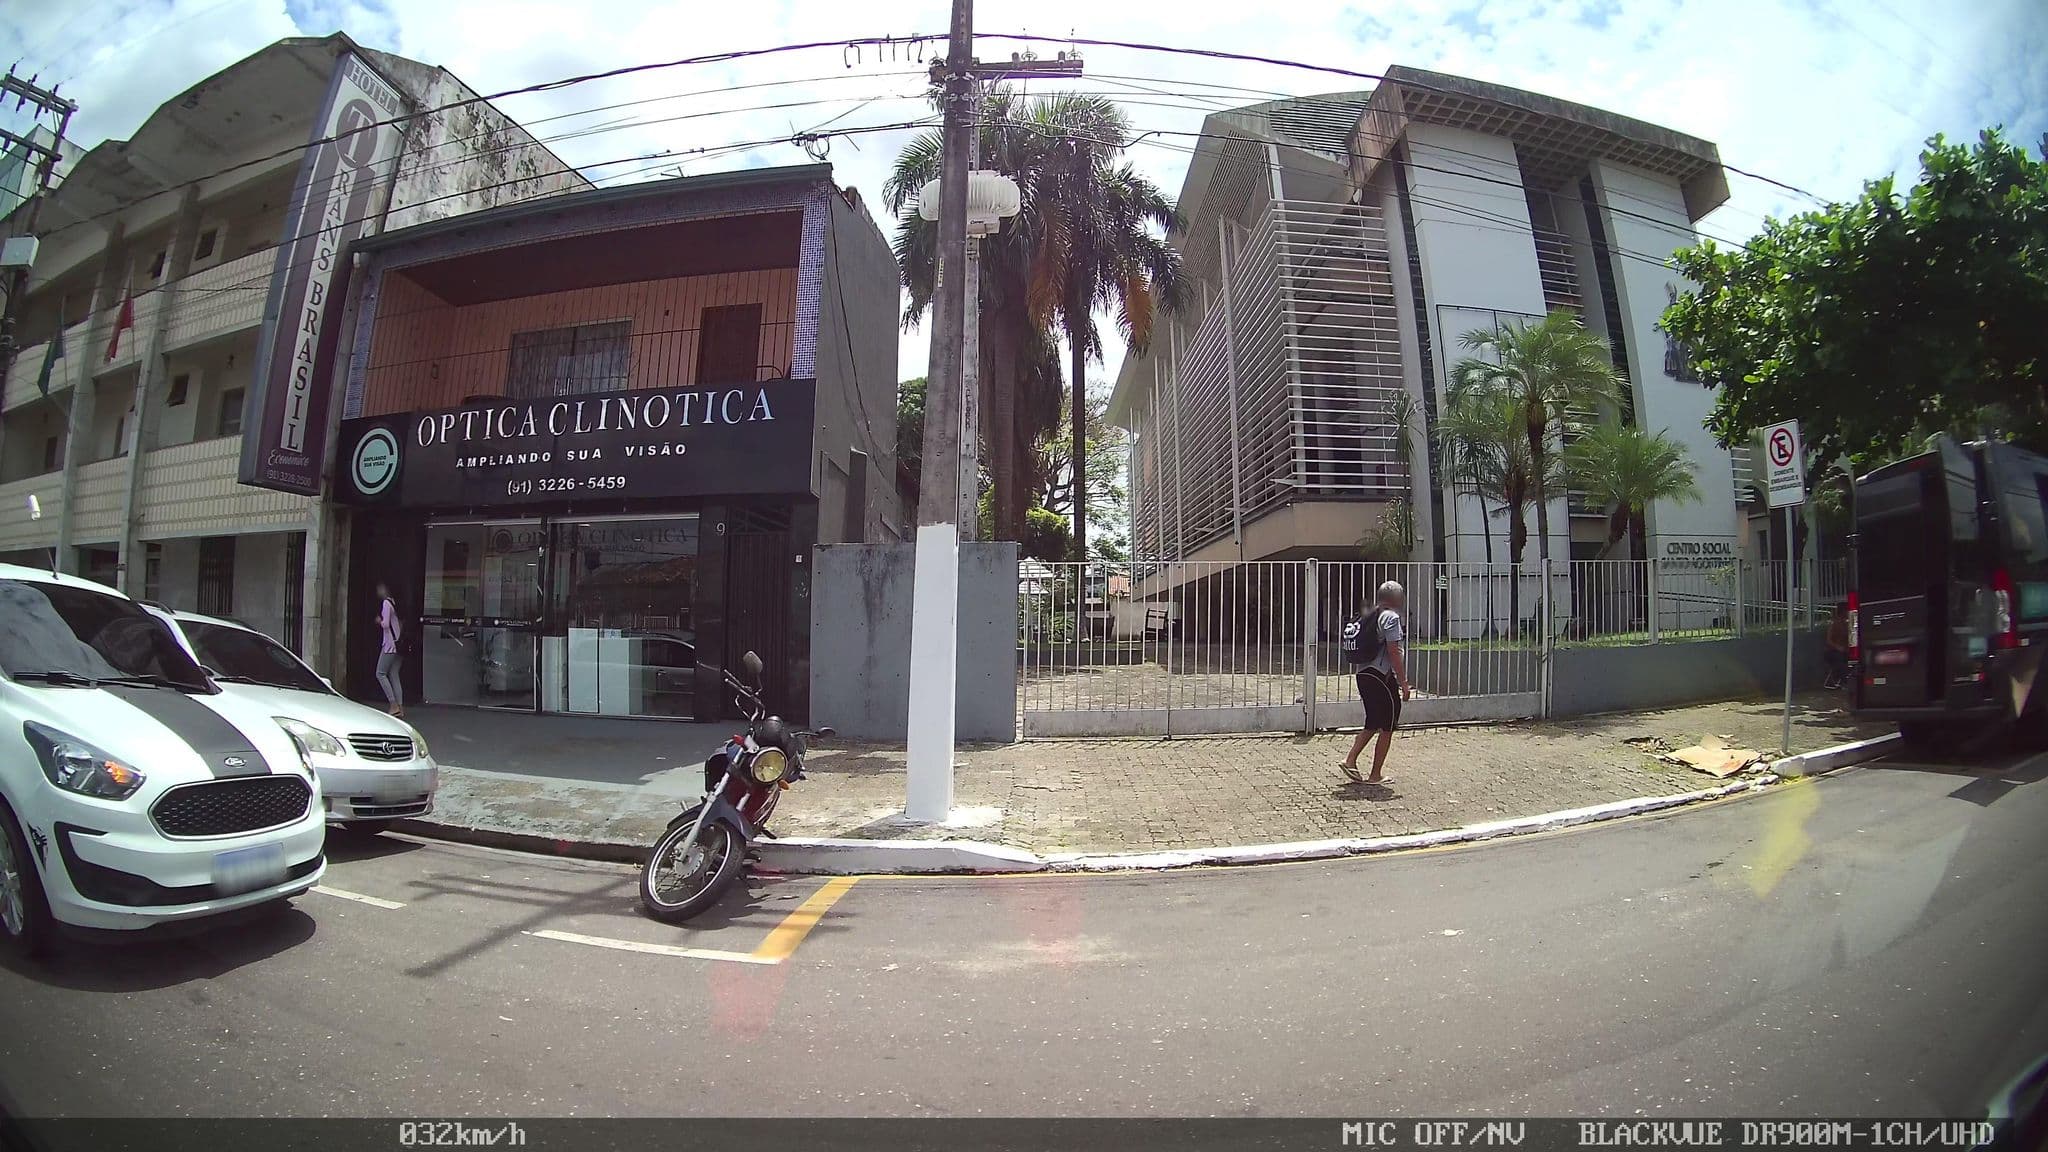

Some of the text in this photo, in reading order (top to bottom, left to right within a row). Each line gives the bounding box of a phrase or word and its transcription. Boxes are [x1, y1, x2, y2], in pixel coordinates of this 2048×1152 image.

[349, 63, 393, 111] HOTEL
[418, 388, 775, 447] OPTICA CLINOTICA
[456, 442, 686, 468] AMPLIANDO SUA VISÃO
[508, 476, 626, 496] (91) 3226-5459
[1667, 542, 1731, 555] CENTRO SOCIAL
